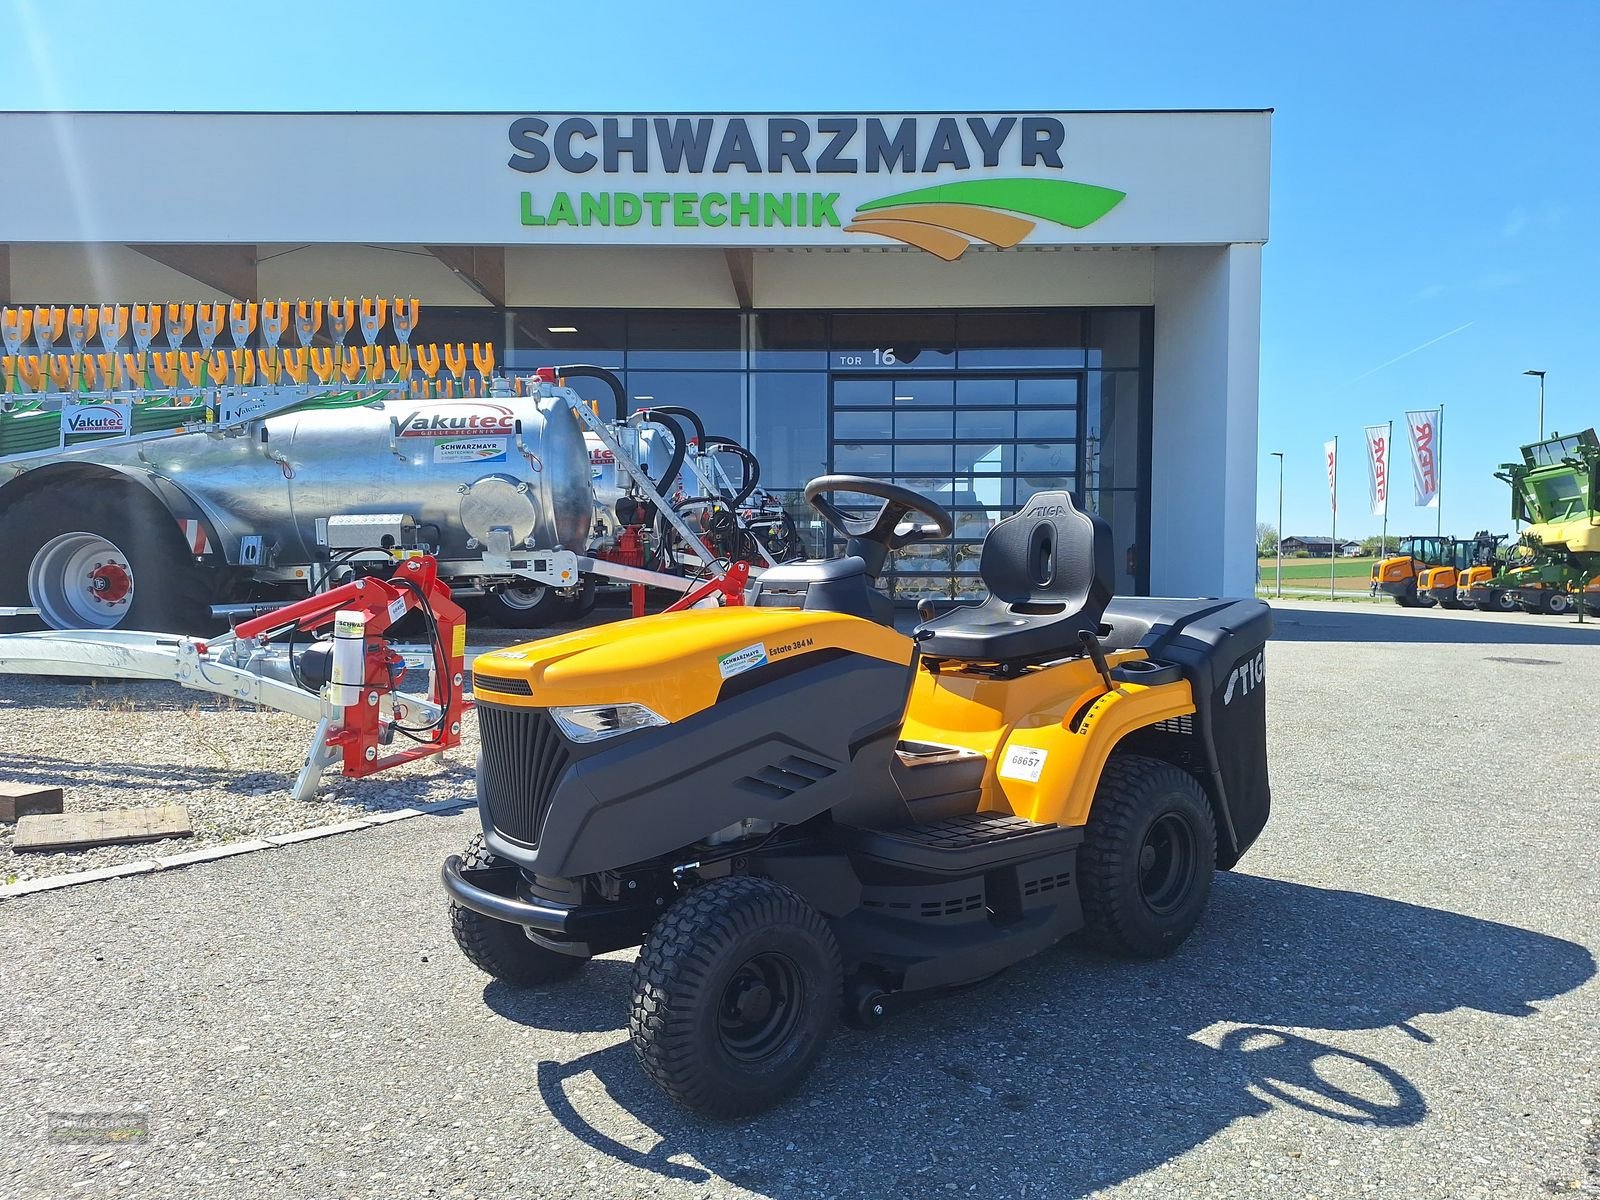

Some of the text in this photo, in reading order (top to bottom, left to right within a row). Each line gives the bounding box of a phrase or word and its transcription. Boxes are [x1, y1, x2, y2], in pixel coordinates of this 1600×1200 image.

[508, 116, 1065, 174] SCHWARZMAYR
[521, 191, 842, 228] LANDTECHNIK
[840, 348, 896, 366] TOR 16
[68, 414, 123, 431] Vakutec
[390, 411, 514, 437] Vakutec
[1027, 505, 1066, 518] STIGA
[769, 638, 813, 656] Estate 384 M
[722, 649, 760, 666] SCHWARZMAYR
[1012, 755, 1040, 767] 68657
